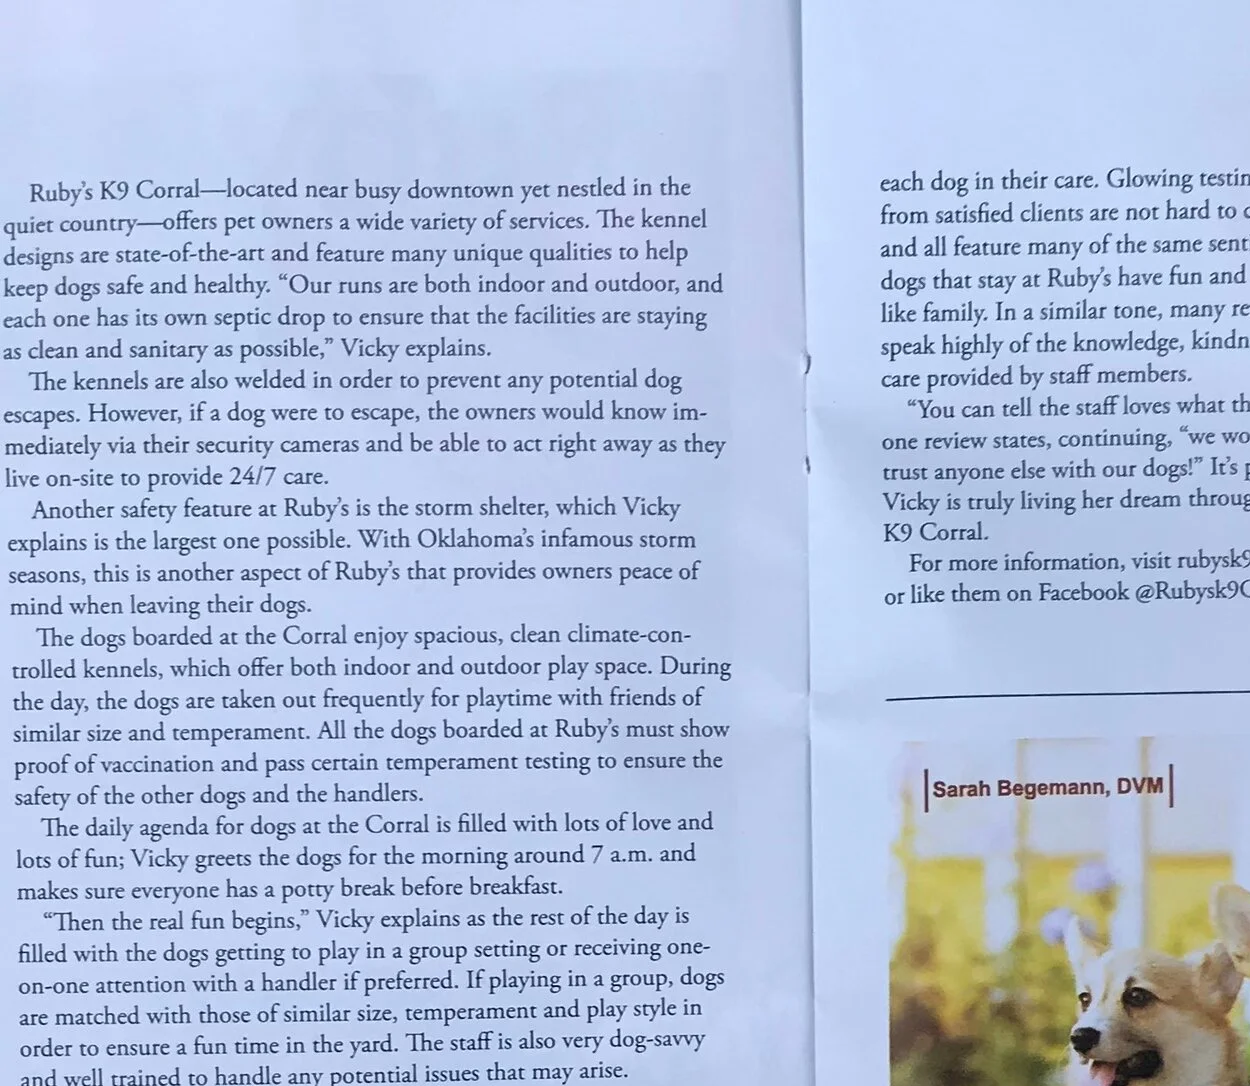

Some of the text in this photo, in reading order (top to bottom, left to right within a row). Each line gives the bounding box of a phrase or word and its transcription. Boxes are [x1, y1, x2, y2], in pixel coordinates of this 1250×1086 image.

[30, 176, 691, 208] Ruby’s K9 Corral—located near busy downtown yet nestled in the
[6, 465, 328, 492] live on-site to provide 24/7 care.
[883, 521, 988, 543] K9 Corral.
[909, 553, 942, 573] For
[948, 559, 997, 572] more
[1004, 551, 1125, 574] information,
[1131, 551, 1171, 569] visit
[884, 592, 905, 605] or
[911, 583, 944, 604] like
[951, 582, 1000, 602] them
[1007, 589, 1032, 602] on
[1039, 580, 1130, 601] Facebook
[933, 777, 1163, 799] Sarah Begemann, DVM
